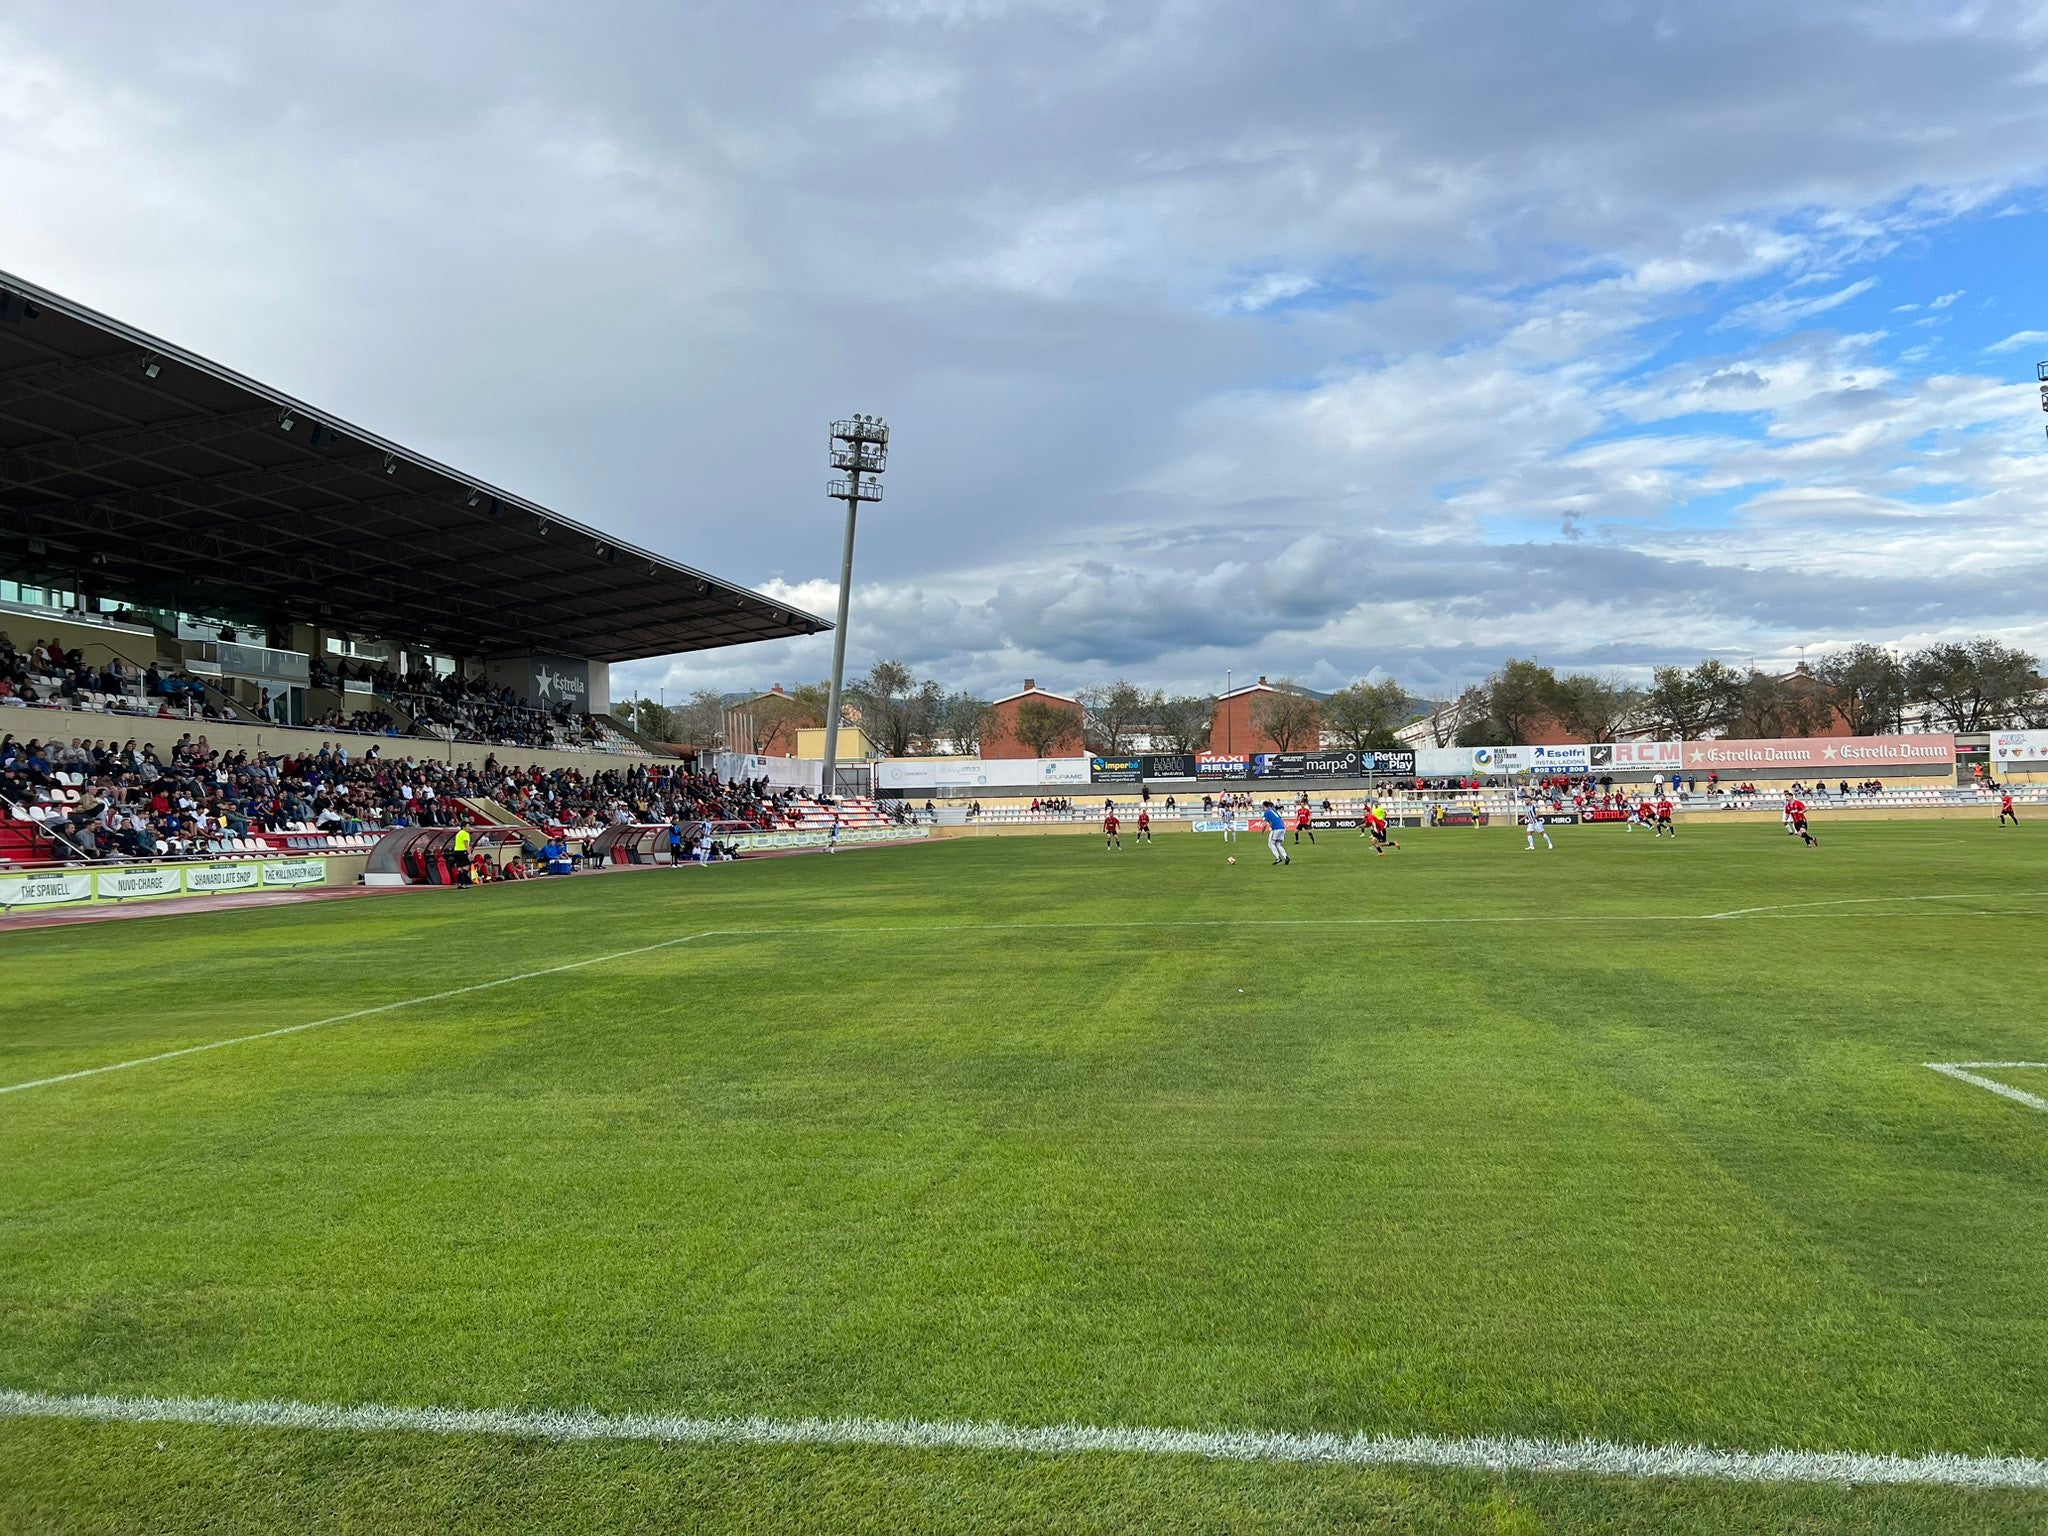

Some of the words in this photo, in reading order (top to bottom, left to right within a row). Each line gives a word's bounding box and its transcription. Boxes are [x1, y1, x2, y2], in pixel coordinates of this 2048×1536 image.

[552, 671, 585, 694] Estrella
[1374, 752, 1413, 761] Return
[1547, 748, 1585, 758] Eselfri
[1615, 743, 1680, 761] RCM
[1707, 747, 1762, 762] Estrella
[1764, 747, 1811, 761] Damm
[1840, 744, 1897, 759] Estrella
[1899, 743, 1948, 758] Damm
[1201, 755, 1244, 763] MAXI
[1306, 759, 1348, 773] marpa
[1378, 761, 1389, 770] to
[1389, 760, 1414, 771] Play
[1201, 763, 1244, 771] REUS
[222, 872, 236, 884] LATE
[236, 871, 251, 883] SHOP
[265, 870, 276, 880] THE
[307, 866, 323, 877] HOUSE
[21, 885, 36, 898] THE
[36, 883, 70, 897] SPAWELL
[118, 877, 163, 891] NUVO-CHARGE
